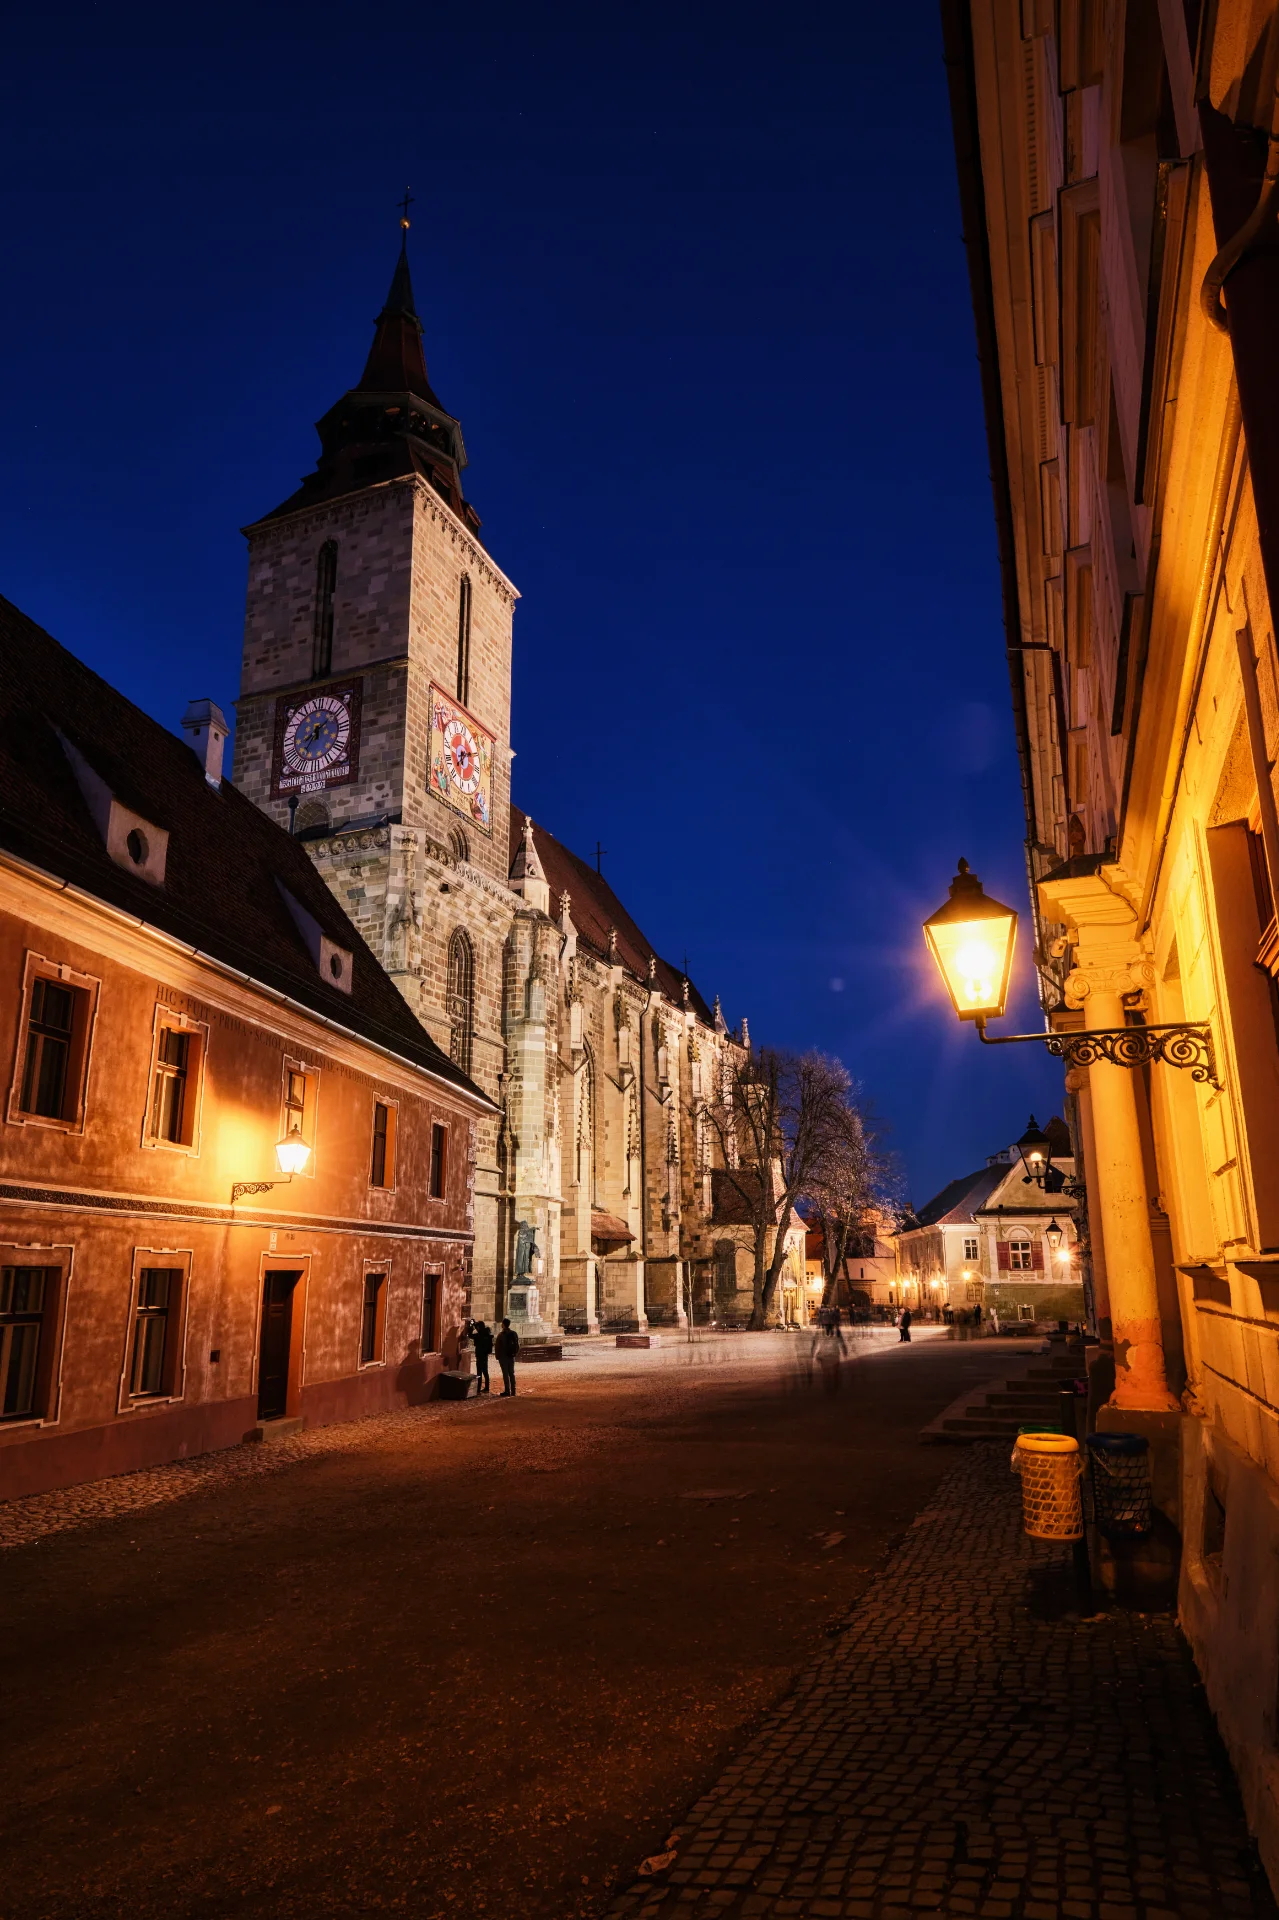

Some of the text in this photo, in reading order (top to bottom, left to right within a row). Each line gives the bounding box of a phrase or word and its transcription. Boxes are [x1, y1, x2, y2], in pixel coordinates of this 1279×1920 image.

[298, 704, 310, 717] XI
[312, 698, 325, 711] XII
[335, 705, 345, 716] II
[339, 719, 350, 732] III
[284, 734, 296, 748] IX
[156, 984, 177, 1006] HIC
[186, 998, 211, 1021] FUIT
[218, 1014, 247, 1036] PRIMA
[255, 1031, 289, 1054] SCHOLA
